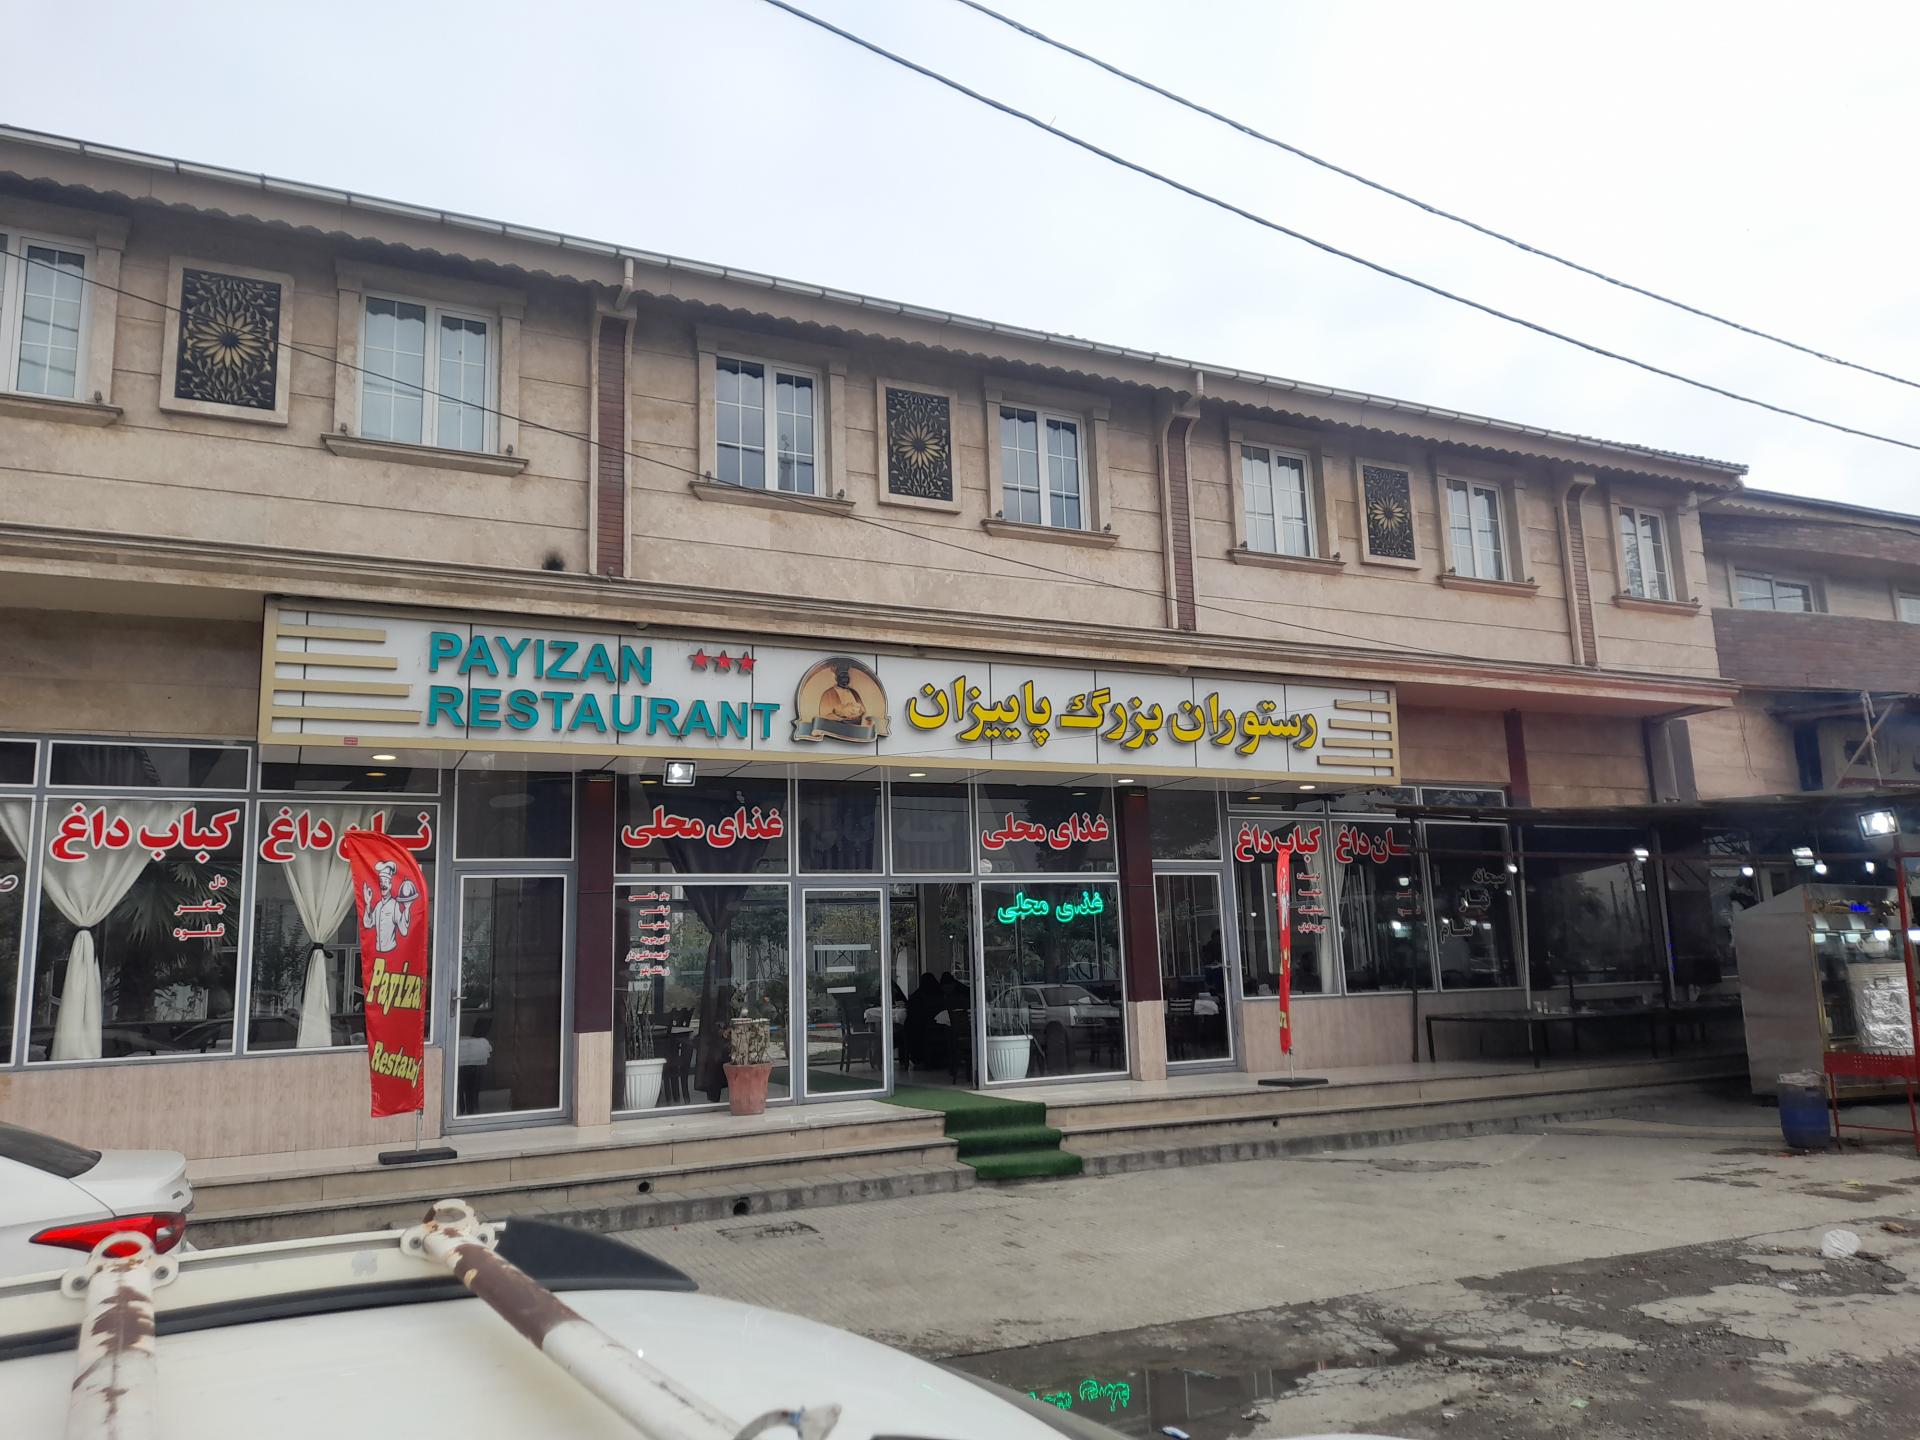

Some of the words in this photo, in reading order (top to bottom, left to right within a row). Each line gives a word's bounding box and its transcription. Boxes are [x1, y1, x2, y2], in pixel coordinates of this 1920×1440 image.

[429, 631, 652, 685] PAYIZAN
[427, 685, 780, 740] RESTAURANT
[1056, 686, 1164, 750] بزرگ
[1168, 691, 1319, 756] رستوران
[50, 803, 130, 863] داغ
[137, 808, 240, 864] کباب
[260, 806, 335, 862] داغ
[621, 804, 705, 848] محلی
[707, 806, 784, 848] غذای
[981, 811, 1047, 850] محلی
[1048, 812, 1109, 850] غذای
[1234, 821, 1274, 863] داغ
[1273, 825, 1321, 864] کباب
[1335, 824, 1371, 863] داغ
[1370, 827, 1416, 864] ان
[209, 873, 228, 891] دل
[997, 891, 1049, 924] محلی
[173, 923, 225, 941] قلوه
[1440, 918, 1474, 944] شام
[366, 957, 424, 1016] Payiza
